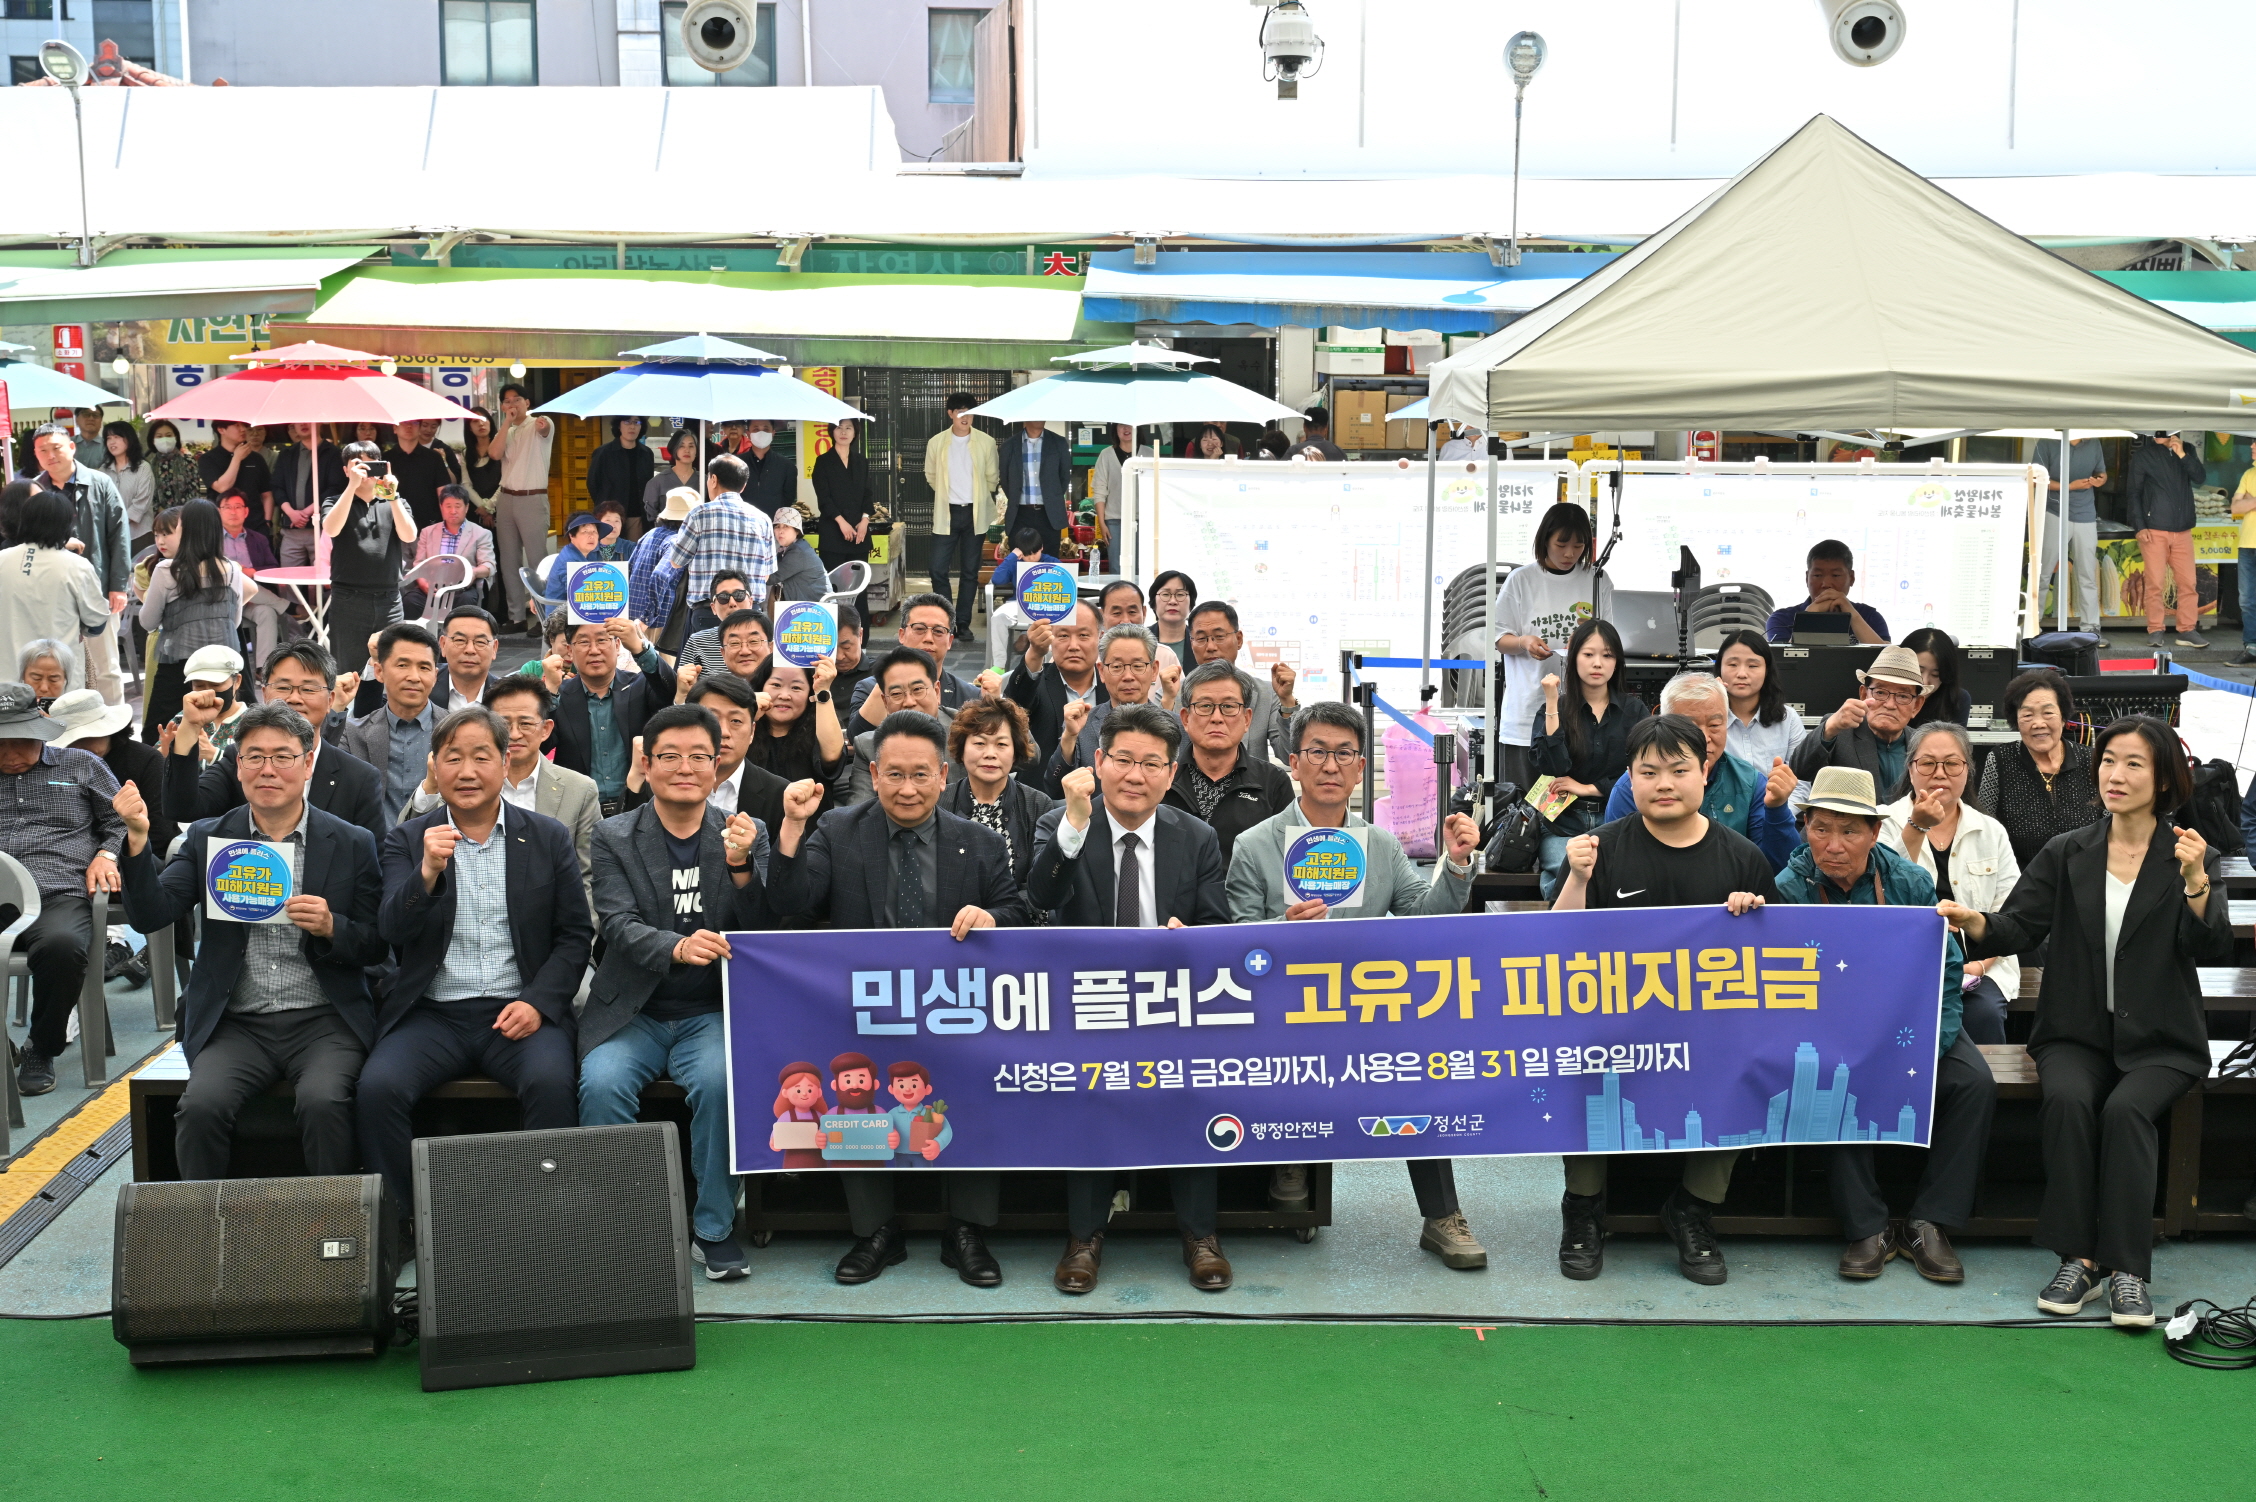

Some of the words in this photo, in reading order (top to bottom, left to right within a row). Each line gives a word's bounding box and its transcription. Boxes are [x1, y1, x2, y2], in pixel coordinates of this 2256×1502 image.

[2200, 547, 2232, 555] 5,000원
[23, 548, 36, 576] REST
[583, 581, 615, 591] 고유가
[1032, 581, 1064, 592] 고유가
[574, 592, 623, 602] 피해지원금
[1023, 592, 1072, 604] 피해지원금
[790, 621, 824, 633] 고유가
[1531, 613, 1577, 629] 가리왕산
[781, 633, 832, 645] 피해지원금
[1540, 627, 1578, 644] 봄나물
[1305, 852, 1348, 866] 고유가
[228, 864, 272, 881] 고유가
[1292, 866, 1358, 880] 피해지원금
[215, 878, 284, 897] 피해지원금
[851, 967, 1050, 1035] 민생에
[1071, 967, 1255, 1032] 플러스
[1284, 956, 1480, 1024] 고유가
[1500, 946, 1821, 1019] 피해지원금
[993, 1061, 1077, 1094] 신청은
[1081, 1060, 1131, 1091] 7월
[1135, 1058, 1185, 1090] 3일
[1189, 1055, 1334, 1089] 금요일까지,
[1340, 1051, 1423, 1085] 사용은
[1426, 1050, 1476, 1081] 8월
[1480, 1047, 1551, 1079] 31일
[1554, 1041, 1691, 1075] 월요일까지
[824, 1120, 860, 1129] CREDIT
[861, 1119, 889, 1128] CARD
[1250, 1121, 1334, 1140] 행정안전부
[1433, 1114, 1485, 1133] 정선군
